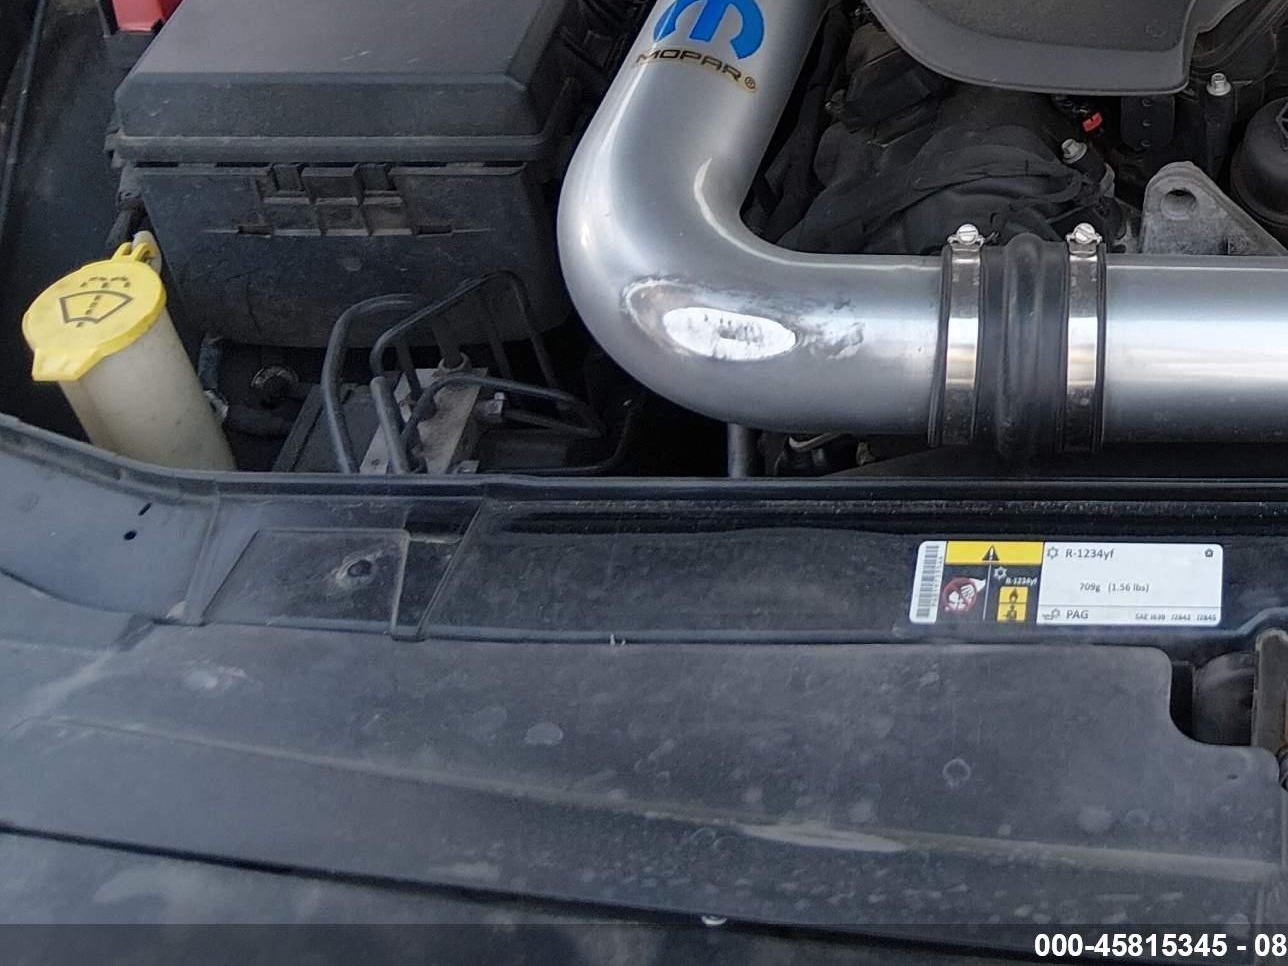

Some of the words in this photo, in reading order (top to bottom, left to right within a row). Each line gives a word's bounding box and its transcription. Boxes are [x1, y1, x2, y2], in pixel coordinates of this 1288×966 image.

[1065, 547, 1114, 560] R-1234yf
[1079, 582, 1101, 593] 709g
[1107, 582, 1130, 594] (1.56
[1066, 609, 1089, 620] PAG
